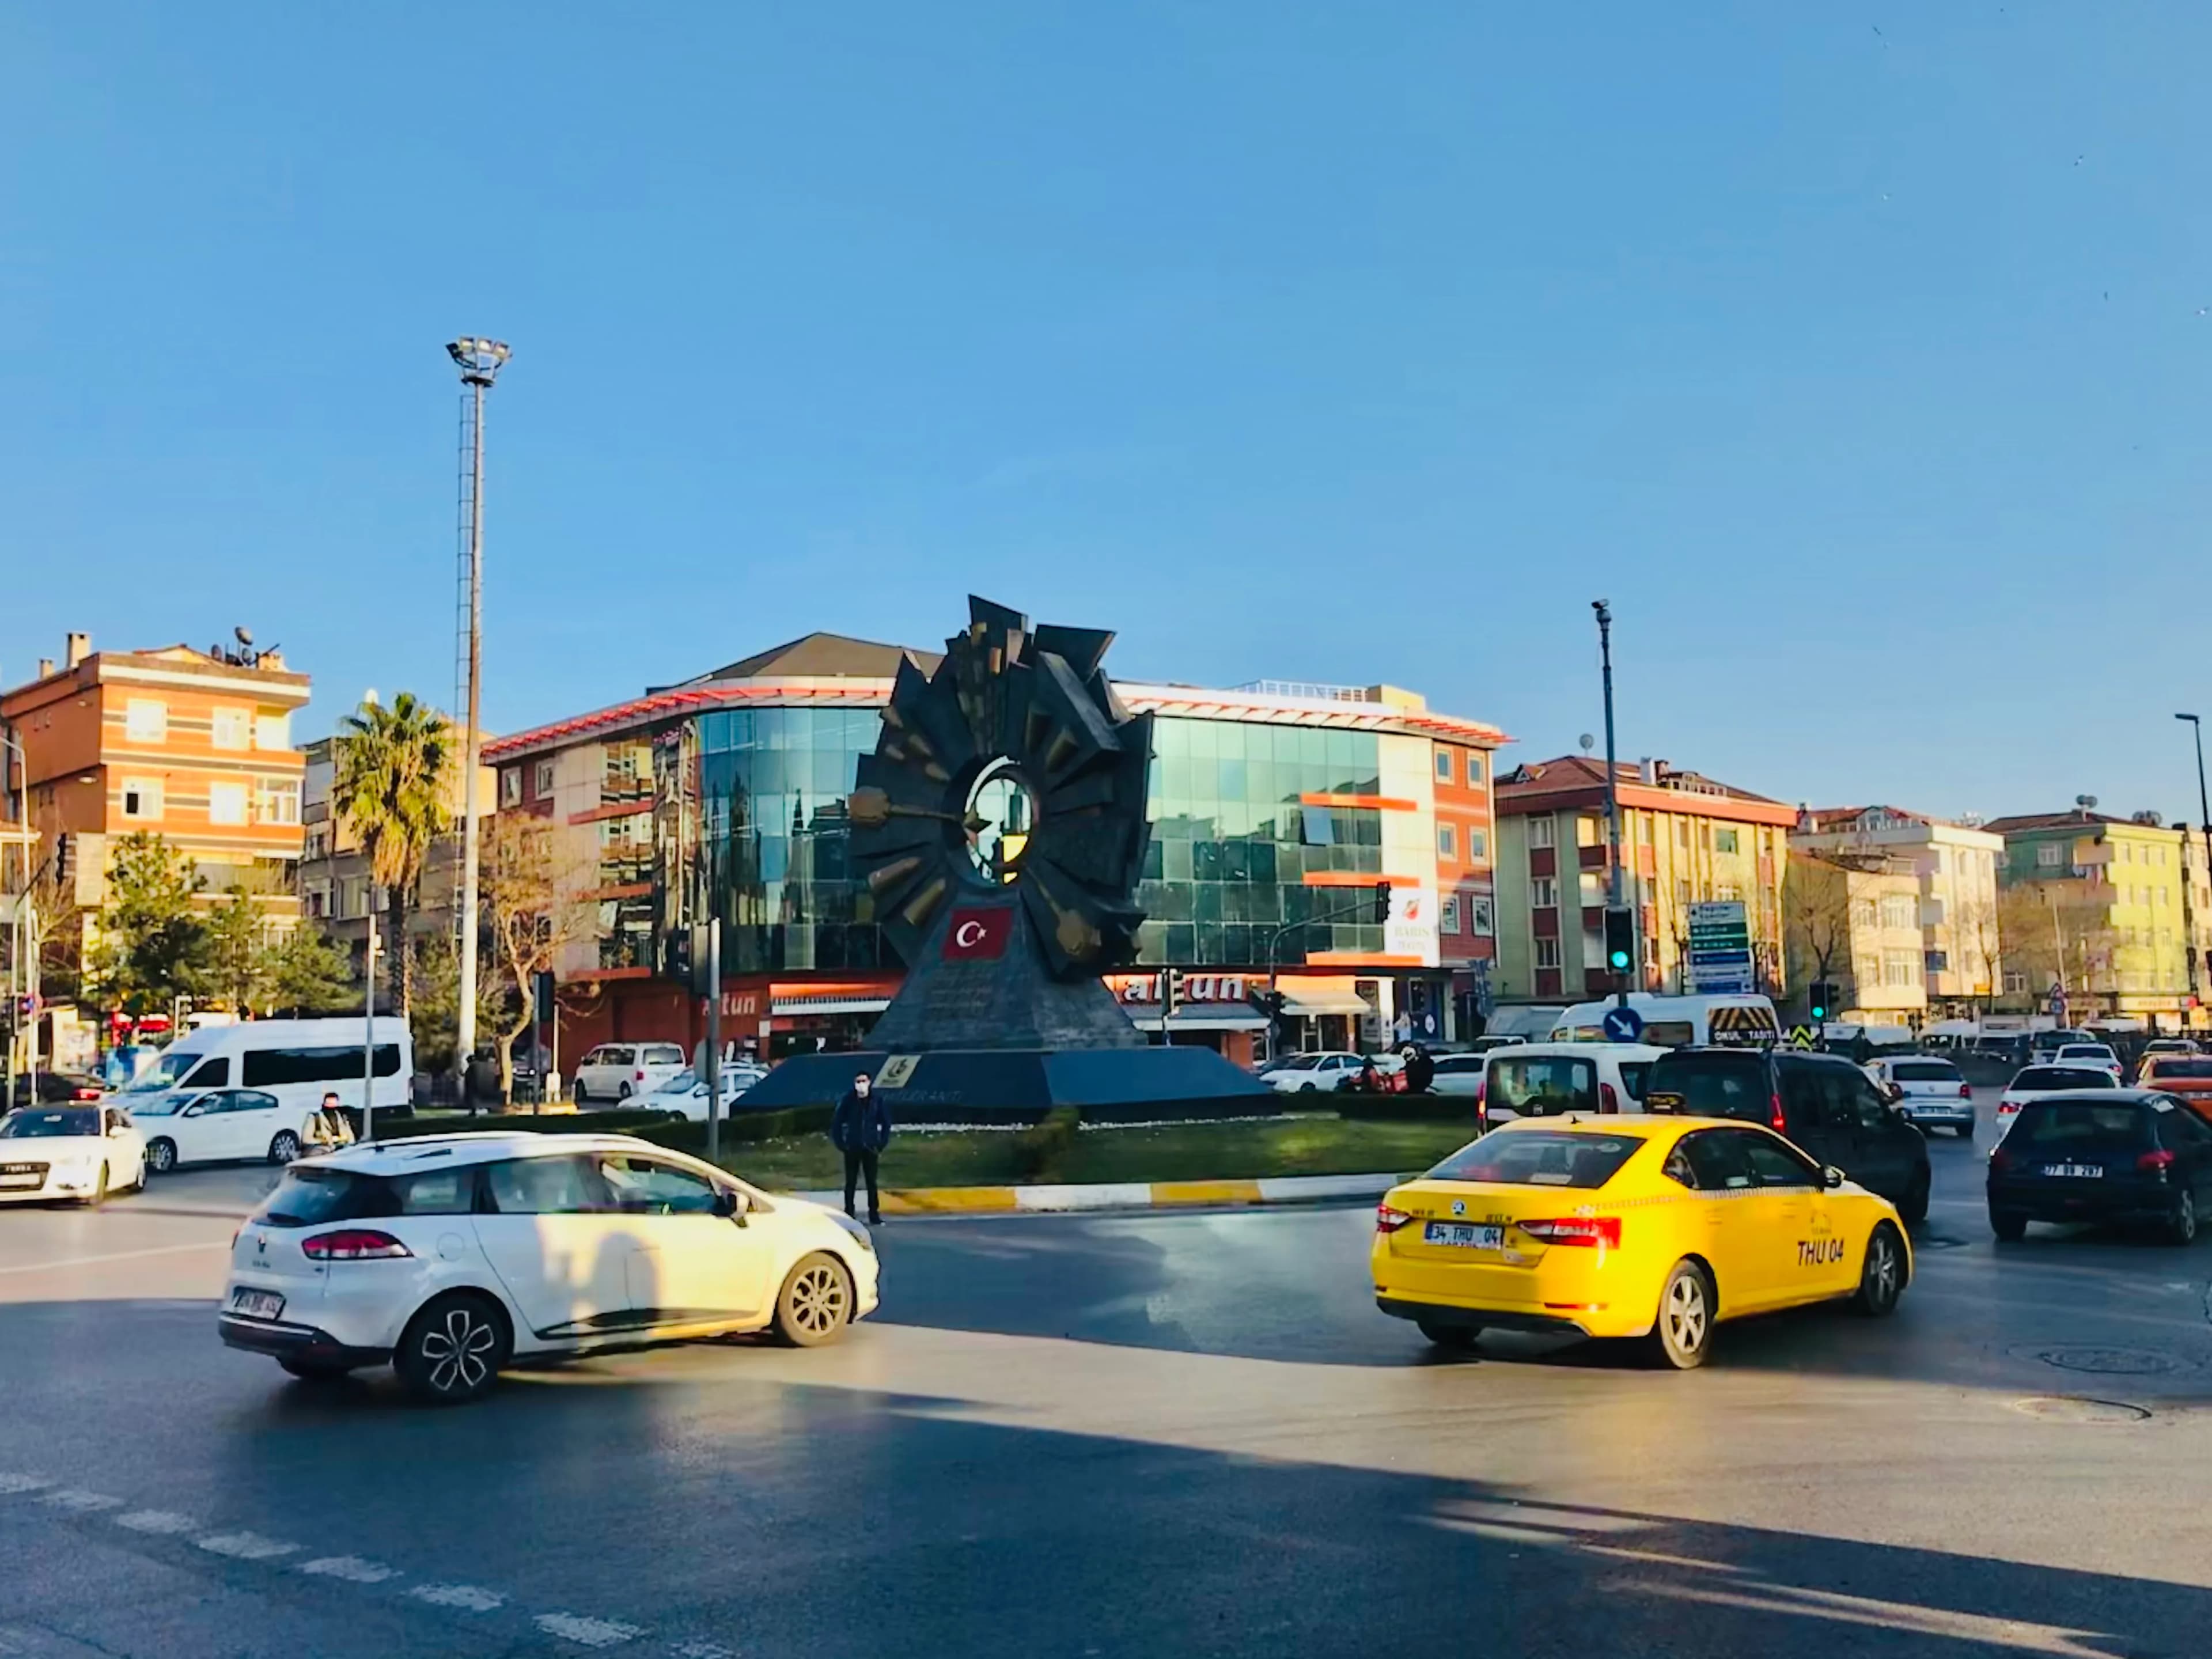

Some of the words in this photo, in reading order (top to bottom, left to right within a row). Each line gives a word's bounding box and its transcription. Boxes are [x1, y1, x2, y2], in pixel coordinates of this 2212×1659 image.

[1124, 974, 1243, 1000] alun
[702, 992, 755, 1015] atun
[1433, 1225, 1446, 1239] 34
[1453, 1227, 1474, 1241] THU
[1484, 1229, 1498, 1244] 04
[1797, 1239, 1827, 1266] THU
[1830, 1237, 1844, 1263] 04
